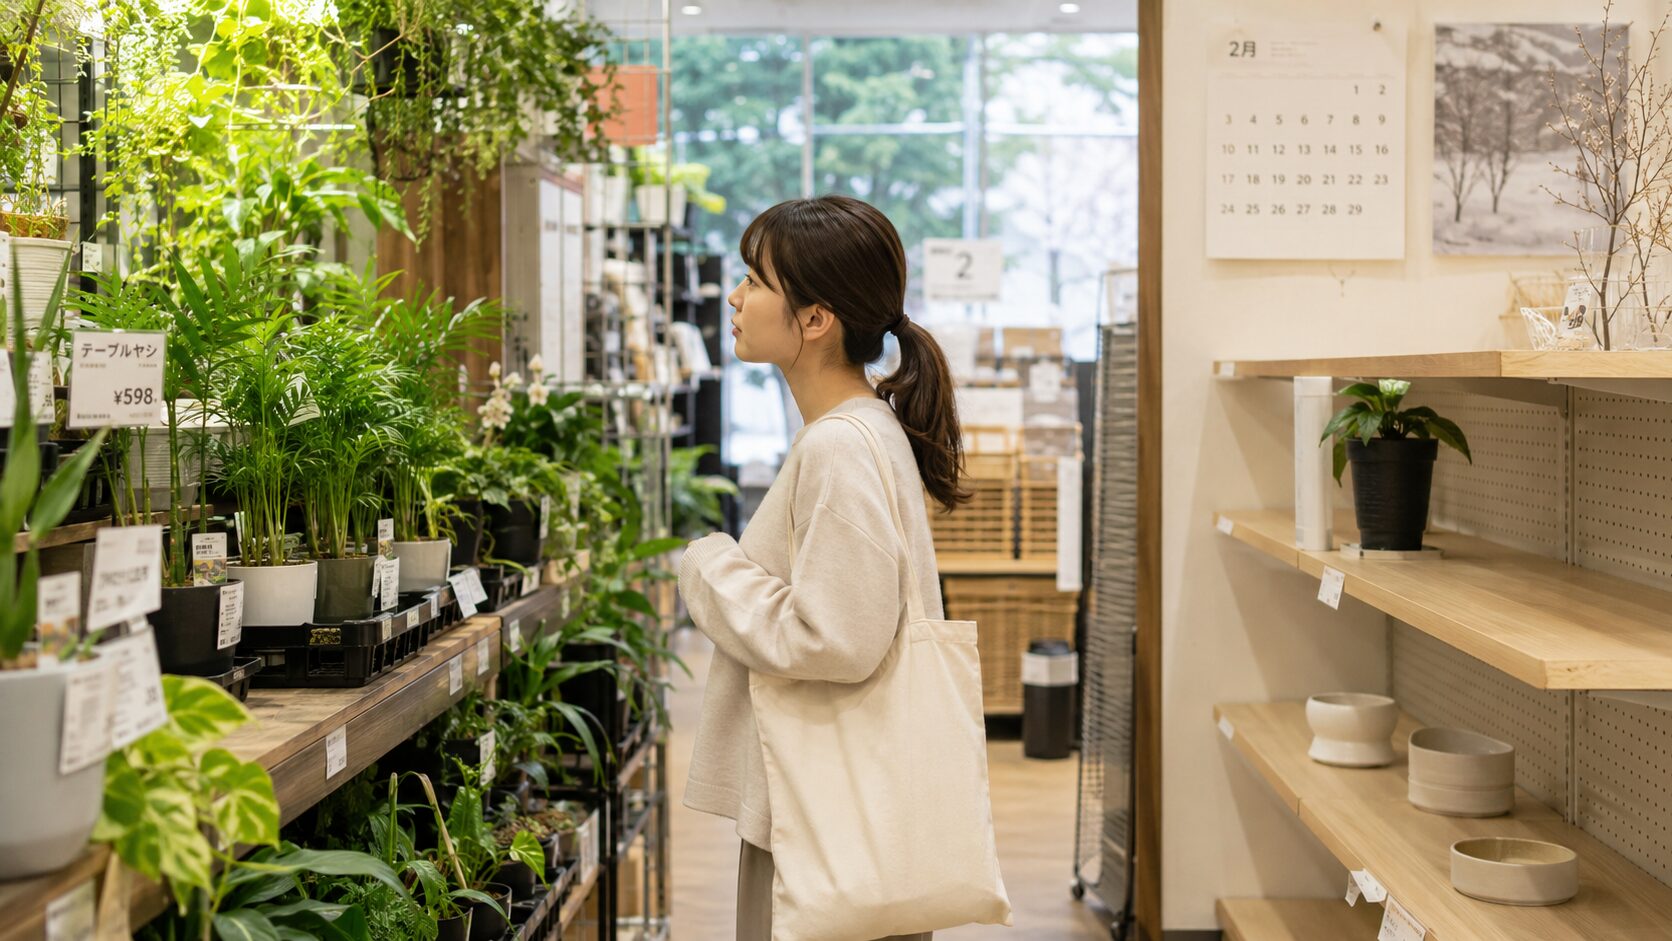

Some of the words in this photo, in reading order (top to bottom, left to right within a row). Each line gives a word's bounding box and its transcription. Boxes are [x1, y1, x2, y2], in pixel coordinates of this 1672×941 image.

[1229, 40, 1257, 58] 2月
[1353, 84, 1359, 96] 1
[1378, 84, 1387, 96] 2
[1225, 114, 1233, 126] 3
[1249, 114, 1258, 126] 4
[1275, 114, 1284, 126] 5
[1300, 114, 1309, 126] 6
[1327, 114, 1335, 126] 7
[1352, 114, 1361, 126] 8
[1377, 114, 1387, 126] 9
[1222, 144, 1236, 156] 10
[1247, 144, 1260, 156] 11
[1272, 144, 1286, 156] 12
[1298, 144, 1312, 156] 13
[1324, 144, 1336, 156] 14
[1350, 144, 1362, 156] 15
[1376, 144, 1390, 156] 16
[1222, 174, 1236, 186] 17
[1246, 174, 1260, 186] 18
[1272, 174, 1286, 186] 19
[1296, 174, 1312, 186] 20
[1322, 174, 1336, 186] 21
[1348, 174, 1362, 186] 22
[1374, 174, 1388, 186] 23
[1220, 204, 1236, 216] 24
[1246, 204, 1260, 216] 25
[1272, 204, 1286, 216] 26
[1296, 204, 1312, 216] 27
[1322, 204, 1336, 216] 28
[1348, 204, 1362, 216] 29
[955, 251, 973, 280] 2
[81, 342, 158, 359] テーブルヤシ
